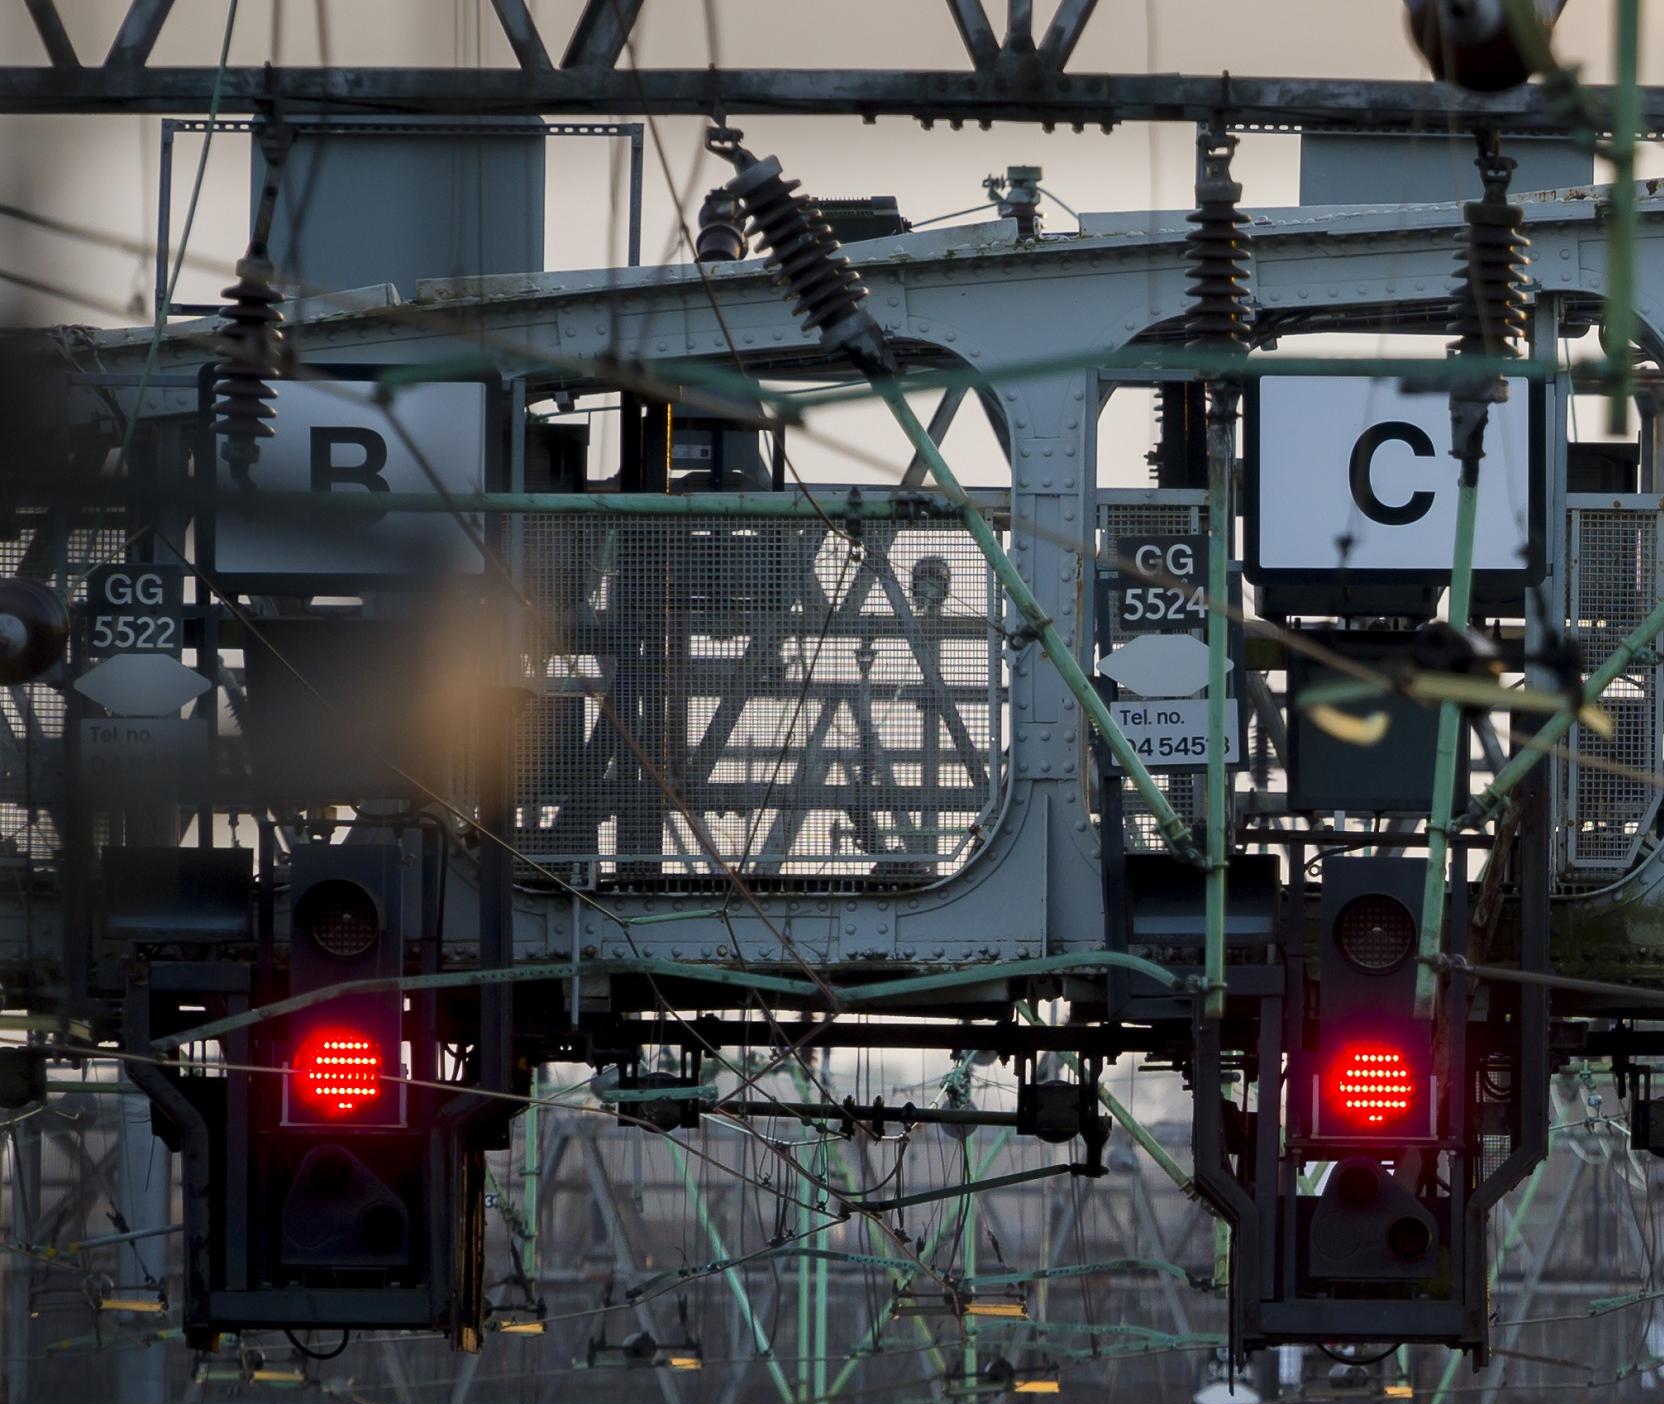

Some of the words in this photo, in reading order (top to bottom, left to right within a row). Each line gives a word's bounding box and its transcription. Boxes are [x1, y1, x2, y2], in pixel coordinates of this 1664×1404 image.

[1348, 420, 1435, 526] C
[1135, 543, 1195, 576] GG
[104, 572, 163, 605] GG
[1122, 586, 1209, 621] 5524
[92, 616, 175, 648] 5522
[1119, 709, 1152, 726] Tel.
[1156, 710, 1185, 725] no.
[1158, 735, 1231, 757] 545
